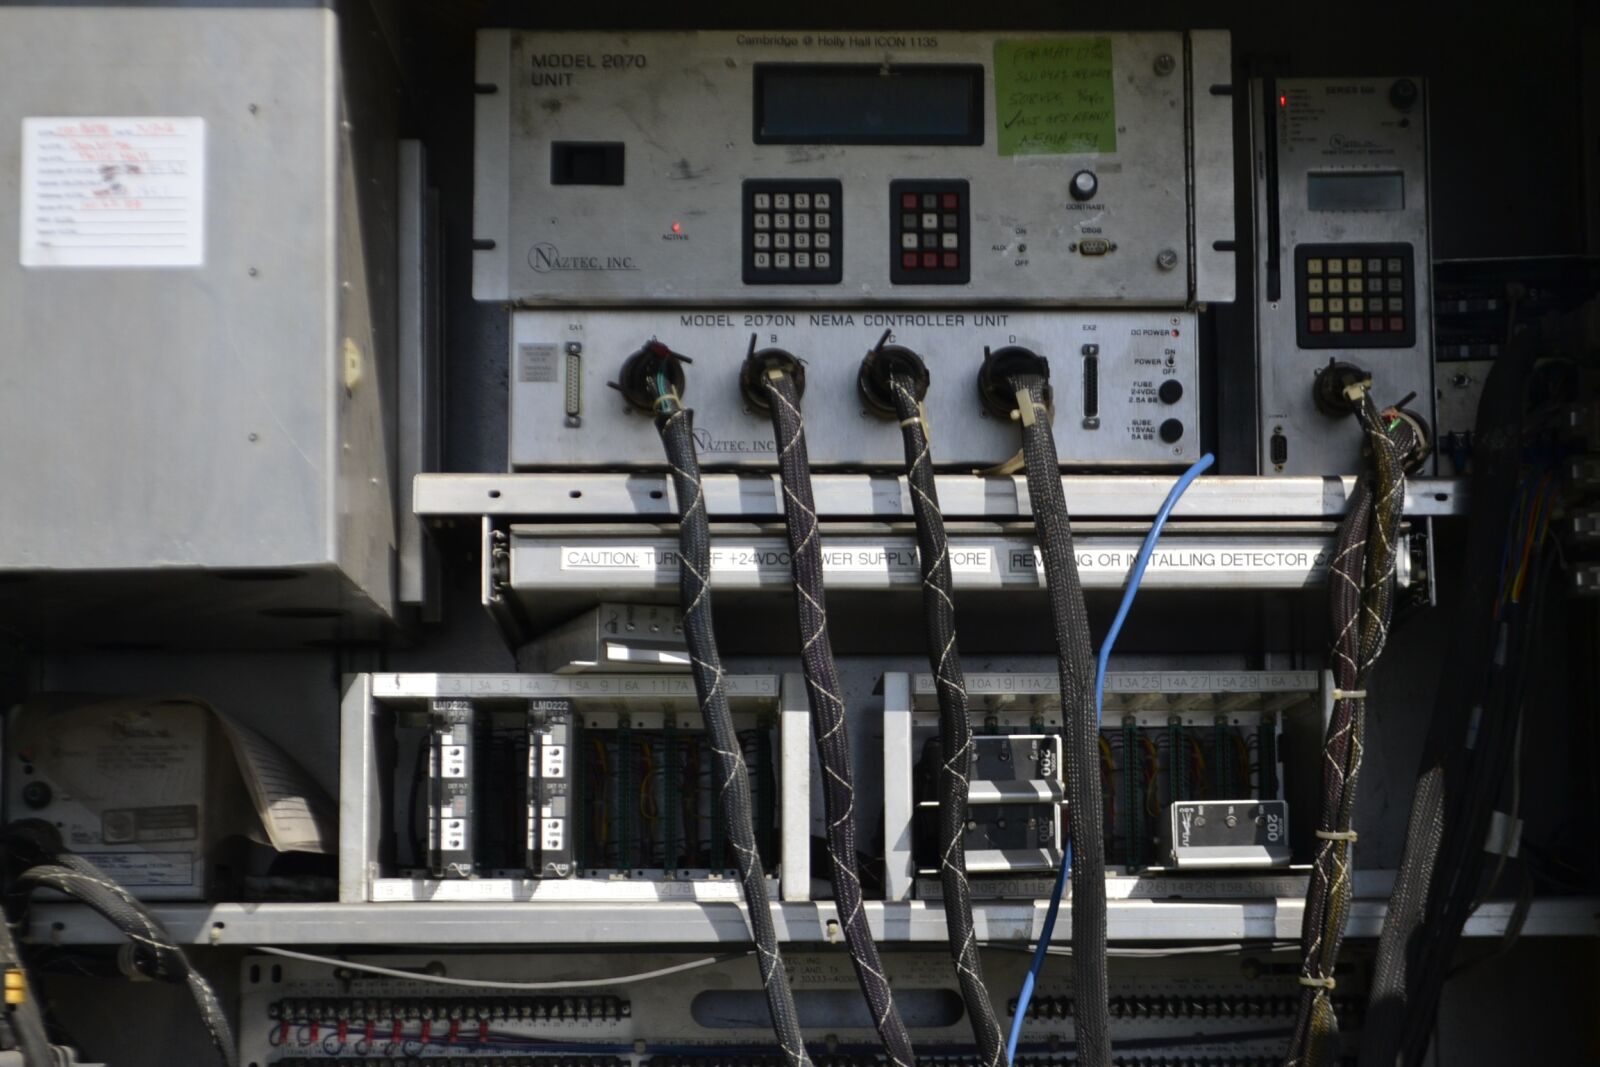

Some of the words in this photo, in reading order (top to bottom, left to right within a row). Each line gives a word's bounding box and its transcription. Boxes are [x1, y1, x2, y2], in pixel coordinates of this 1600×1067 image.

[736, 34, 798, 48] Cambridge
[803, 35, 814, 47] @
[818, 34, 844, 48] Holly
[850, 35, 870, 47] Hall
[910, 36, 938, 47] 1135
[531, 54, 596, 68] MODEL
[602, 54, 647, 68] 2070
[531, 72, 574, 86] UNIT
[607, 256, 637, 268] INC.
[680, 314, 735, 327] MODEL
[744, 314, 795, 327] 2070N
[809, 314, 855, 327] NEMA
[863, 314, 965, 327] CONTROLLER
[973, 314, 1009, 327] UNIT
[770, 334, 777, 343] B
[888, 334, 896, 343] C
[1009, 334, 1017, 343] D
[567, 551, 639, 567] CAUTION:
[645, 552, 681, 565] TURN
[730, 552, 791, 566] +24VDC
[858, 552, 917, 566] SUPPLY
[1012, 553, 1093, 567] REMNG
[1098, 553, 1121, 566] OR
[1126, 552, 1216, 566] INTALLING
[1221, 552, 1308, 566] DETECTOR
[1141, 677, 1160, 689] 25
[1191, 676, 1209, 688] 27
[532, 701, 569, 711] LMD222
[1040, 749, 1051, 777] 200
[1267, 814, 1279, 842] 200
